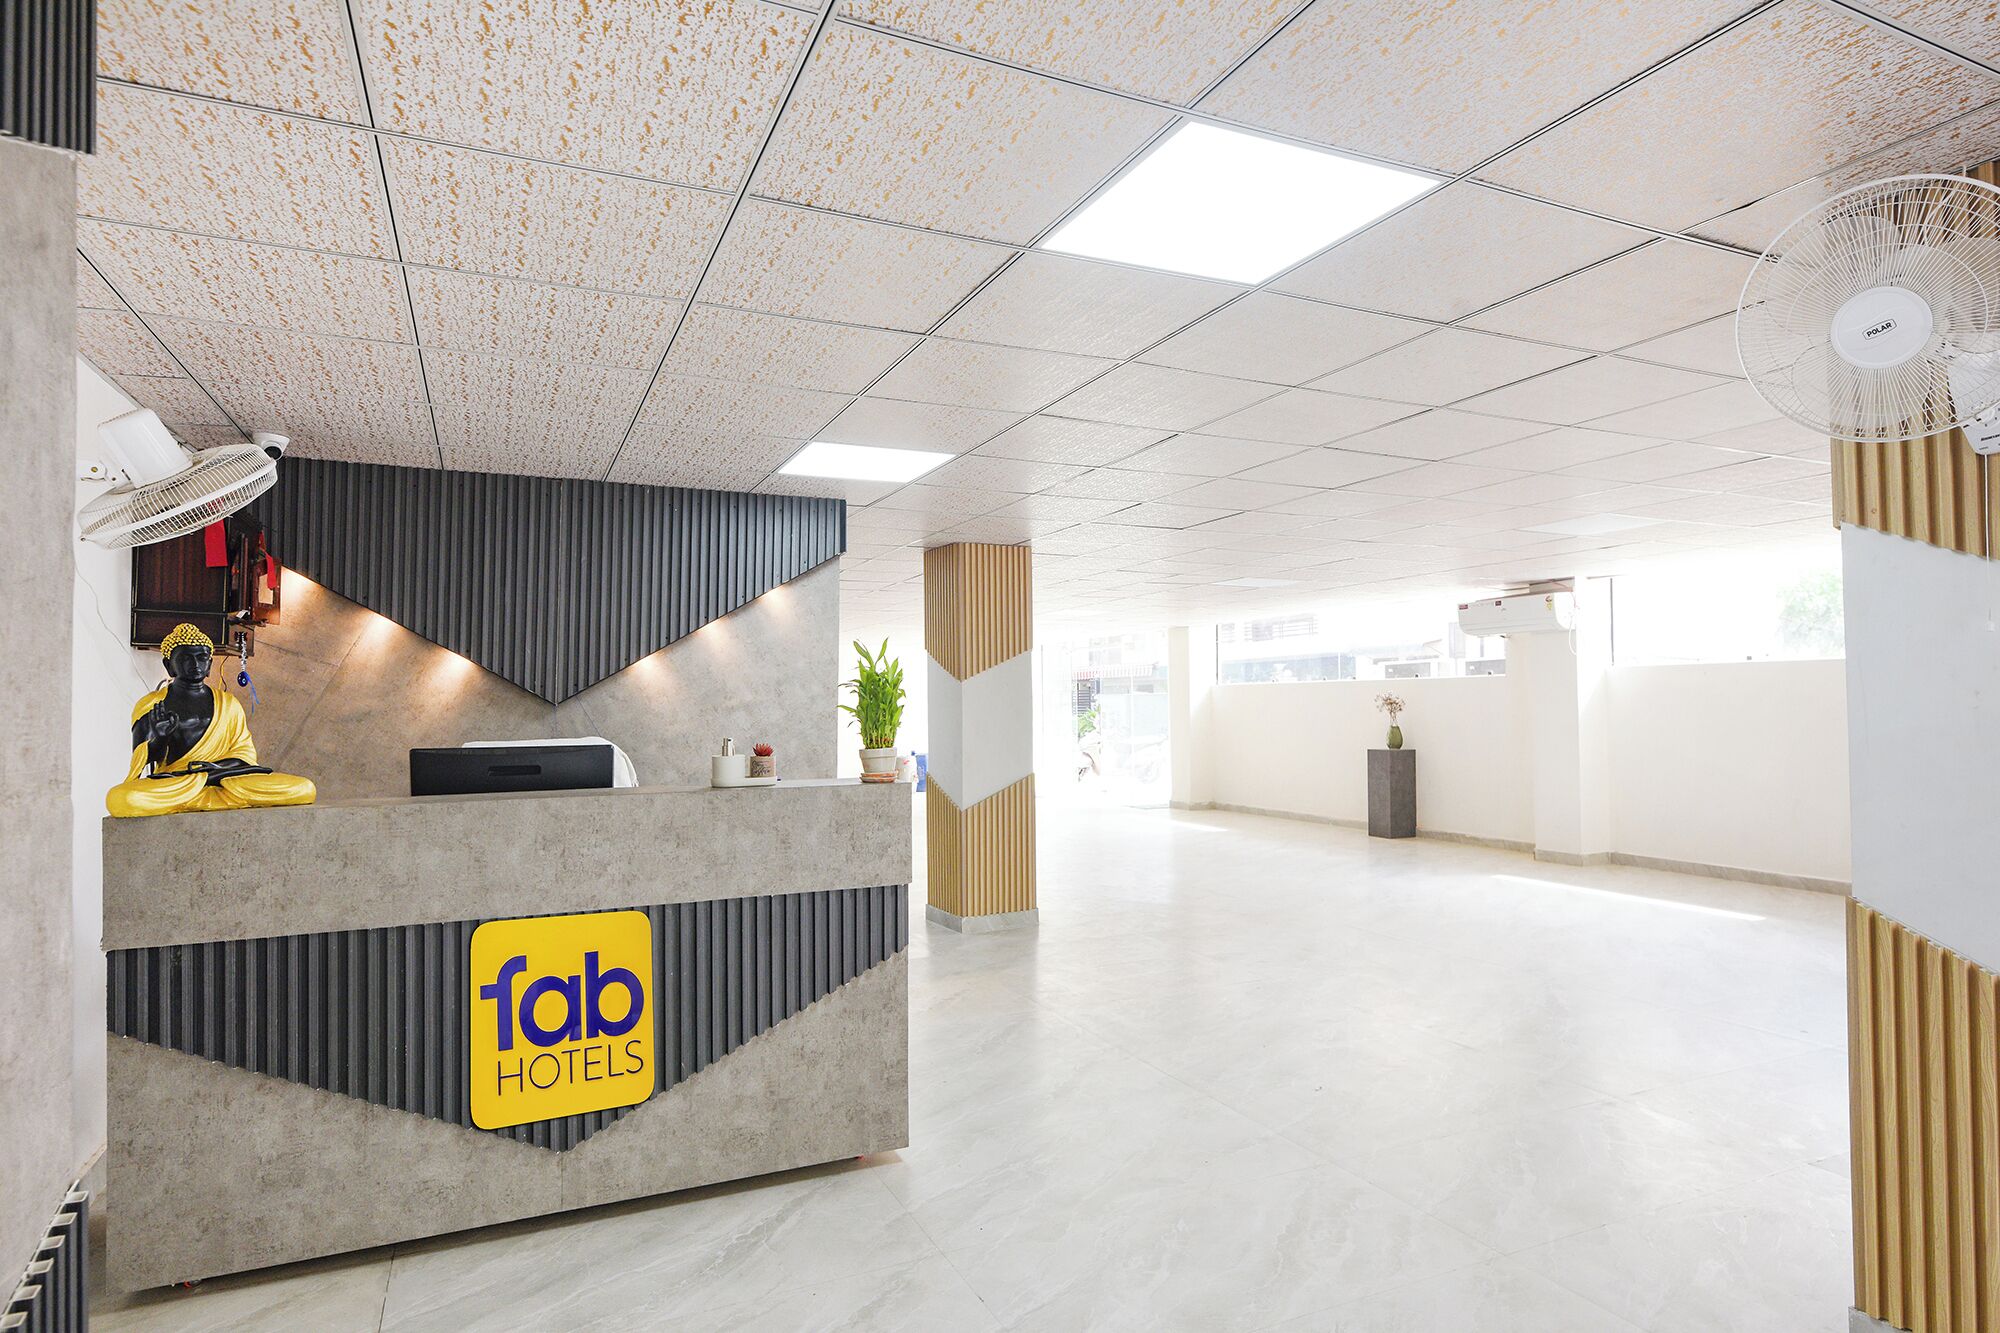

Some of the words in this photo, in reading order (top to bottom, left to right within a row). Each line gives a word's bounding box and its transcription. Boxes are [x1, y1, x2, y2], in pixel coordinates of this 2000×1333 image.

[1866, 321, 1893, 337] POLAR
[480, 951, 644, 1051] fab
[497, 1040, 644, 1096] HOTELS
